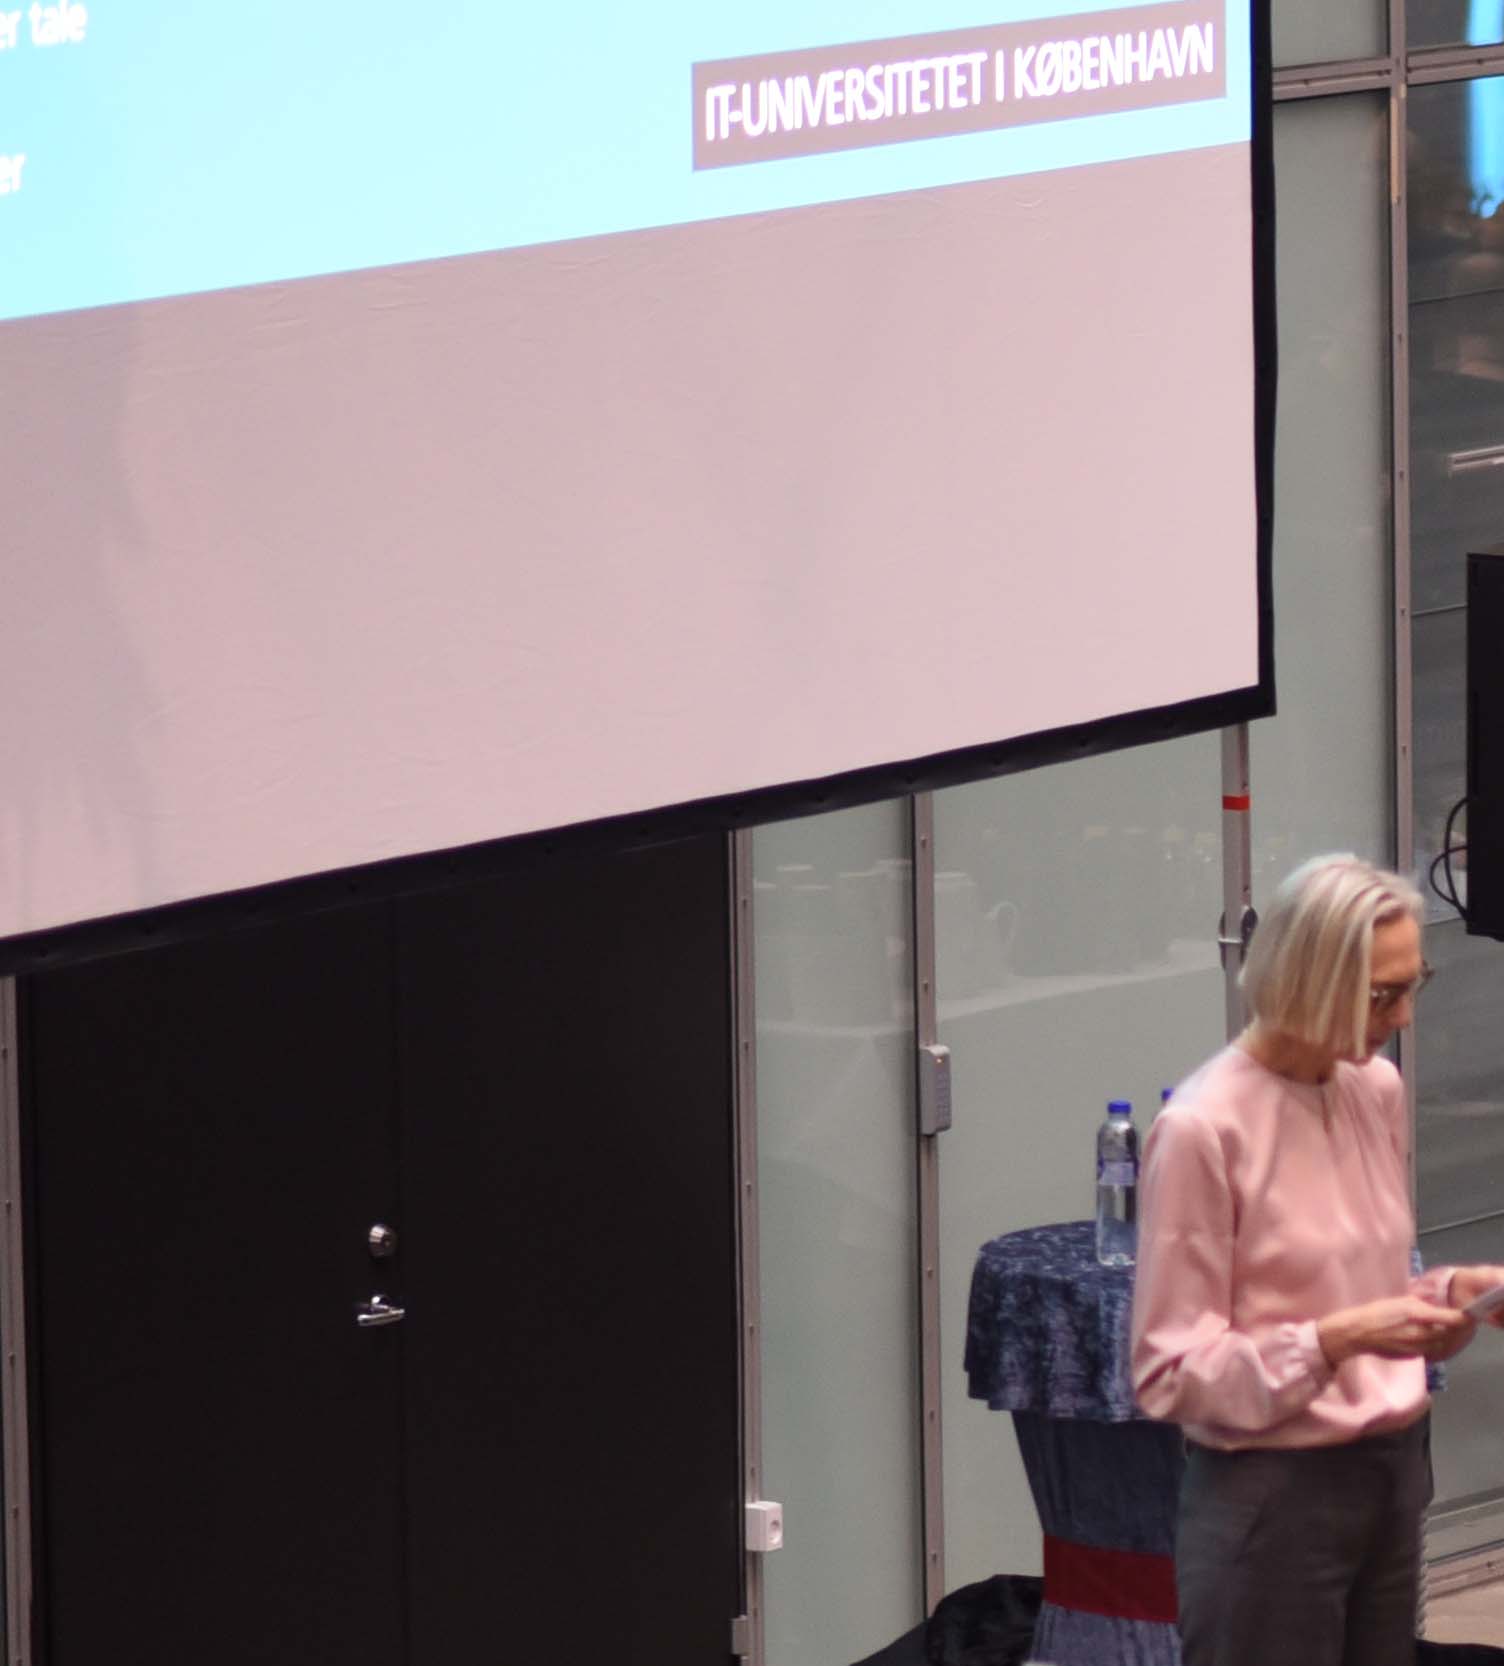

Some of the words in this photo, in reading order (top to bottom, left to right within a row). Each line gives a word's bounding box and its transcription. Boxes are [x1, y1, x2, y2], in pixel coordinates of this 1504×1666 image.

[29, 0, 87, 47] tale
[705, 51, 987, 141] IT-UNIVERSITETET
[995, 50, 1005, 102] I
[1014, 22, 1214, 100] KØBENHAVN
